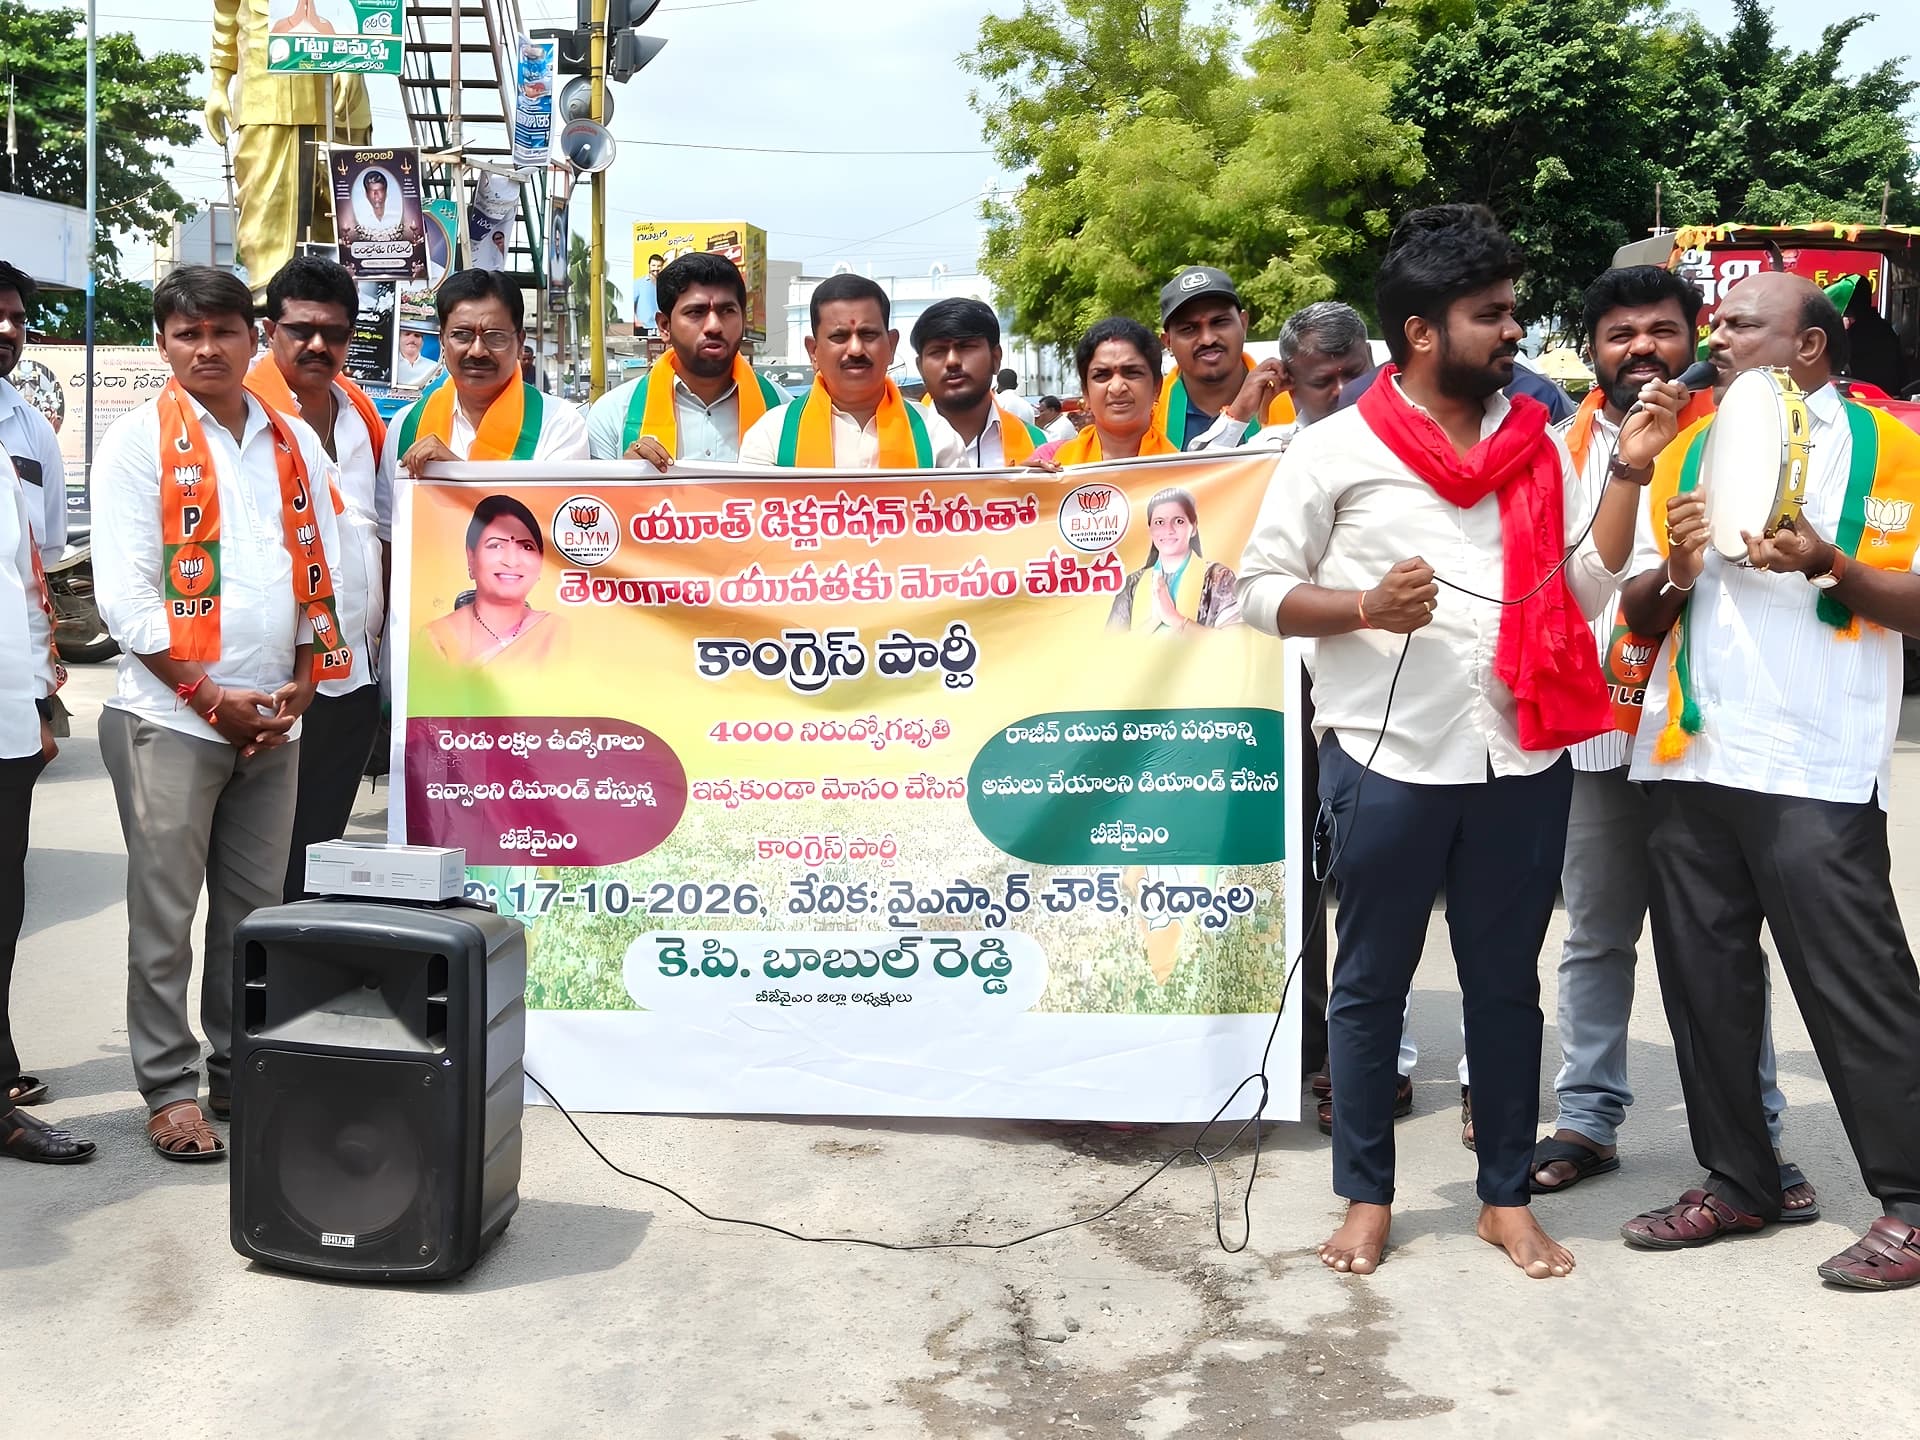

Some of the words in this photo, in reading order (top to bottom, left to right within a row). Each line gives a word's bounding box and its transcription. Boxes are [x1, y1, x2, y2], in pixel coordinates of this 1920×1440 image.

[293, 477, 310, 511] J
[182, 505, 202, 537] P
[633, 502, 753, 541] యూత్
[761, 493, 905, 548] డిక్లరేషన్
[913, 492, 1037, 535] పేరుతో
[1071, 514, 1118, 530] BJYM
[564, 531, 609, 546] BJYM
[308, 564, 323, 595] P
[560, 571, 710, 604] తెలంగాణ
[720, 563, 892, 602] యువతకు
[901, 559, 1017, 599] మోసం
[1026, 549, 1123, 595] చేసిన
[174, 598, 214, 617] BJP
[698, 631, 866, 691] కాంగ్రెస్
[878, 624, 977, 689] పార్టీ
[438, 730, 495, 751] రెండు
[498, 732, 542, 758] లక్షల
[547, 728, 645, 758] ఉద్యోగాలు
[708, 721, 794, 742] 4000
[800, 714, 951, 750] నిరుద్యోగభృతి
[1005, 720, 1060, 744] రాజీవ్
[1064, 721, 1119, 742] యువ
[1122, 720, 1178, 742] వికాస
[426, 780, 505, 807] ఇవ్వాలని
[508, 778, 590, 800] డిమాండ్
[594, 776, 657, 807] చేస్తున్న
[692, 778, 816, 809] ఇవ్వకుండా
[821, 778, 899, 801] మోసం
[904, 773, 966, 801] చేసిన
[981, 775, 1043, 796] అమలు
[1046, 769, 1134, 794] చేయాలని
[1229, 766, 1279, 792] చేసిన
[500, 825, 578, 857] బీజేవైఎం
[757, 835, 844, 867] కాంగ్రెస్
[849, 833, 897, 868] పార్టీ
[1090, 819, 1170, 852] బీజేవైఎం
[887, 873, 1031, 929] వైఎస్సార్
[1140, 880, 1255, 929] గద్వాల
[655, 937, 751, 979] కె.పి.
[763, 936, 923, 979] బాబుల్
[930, 938, 1013, 995] రెడ్డి
[321, 1234, 355, 1247] AHUJA
